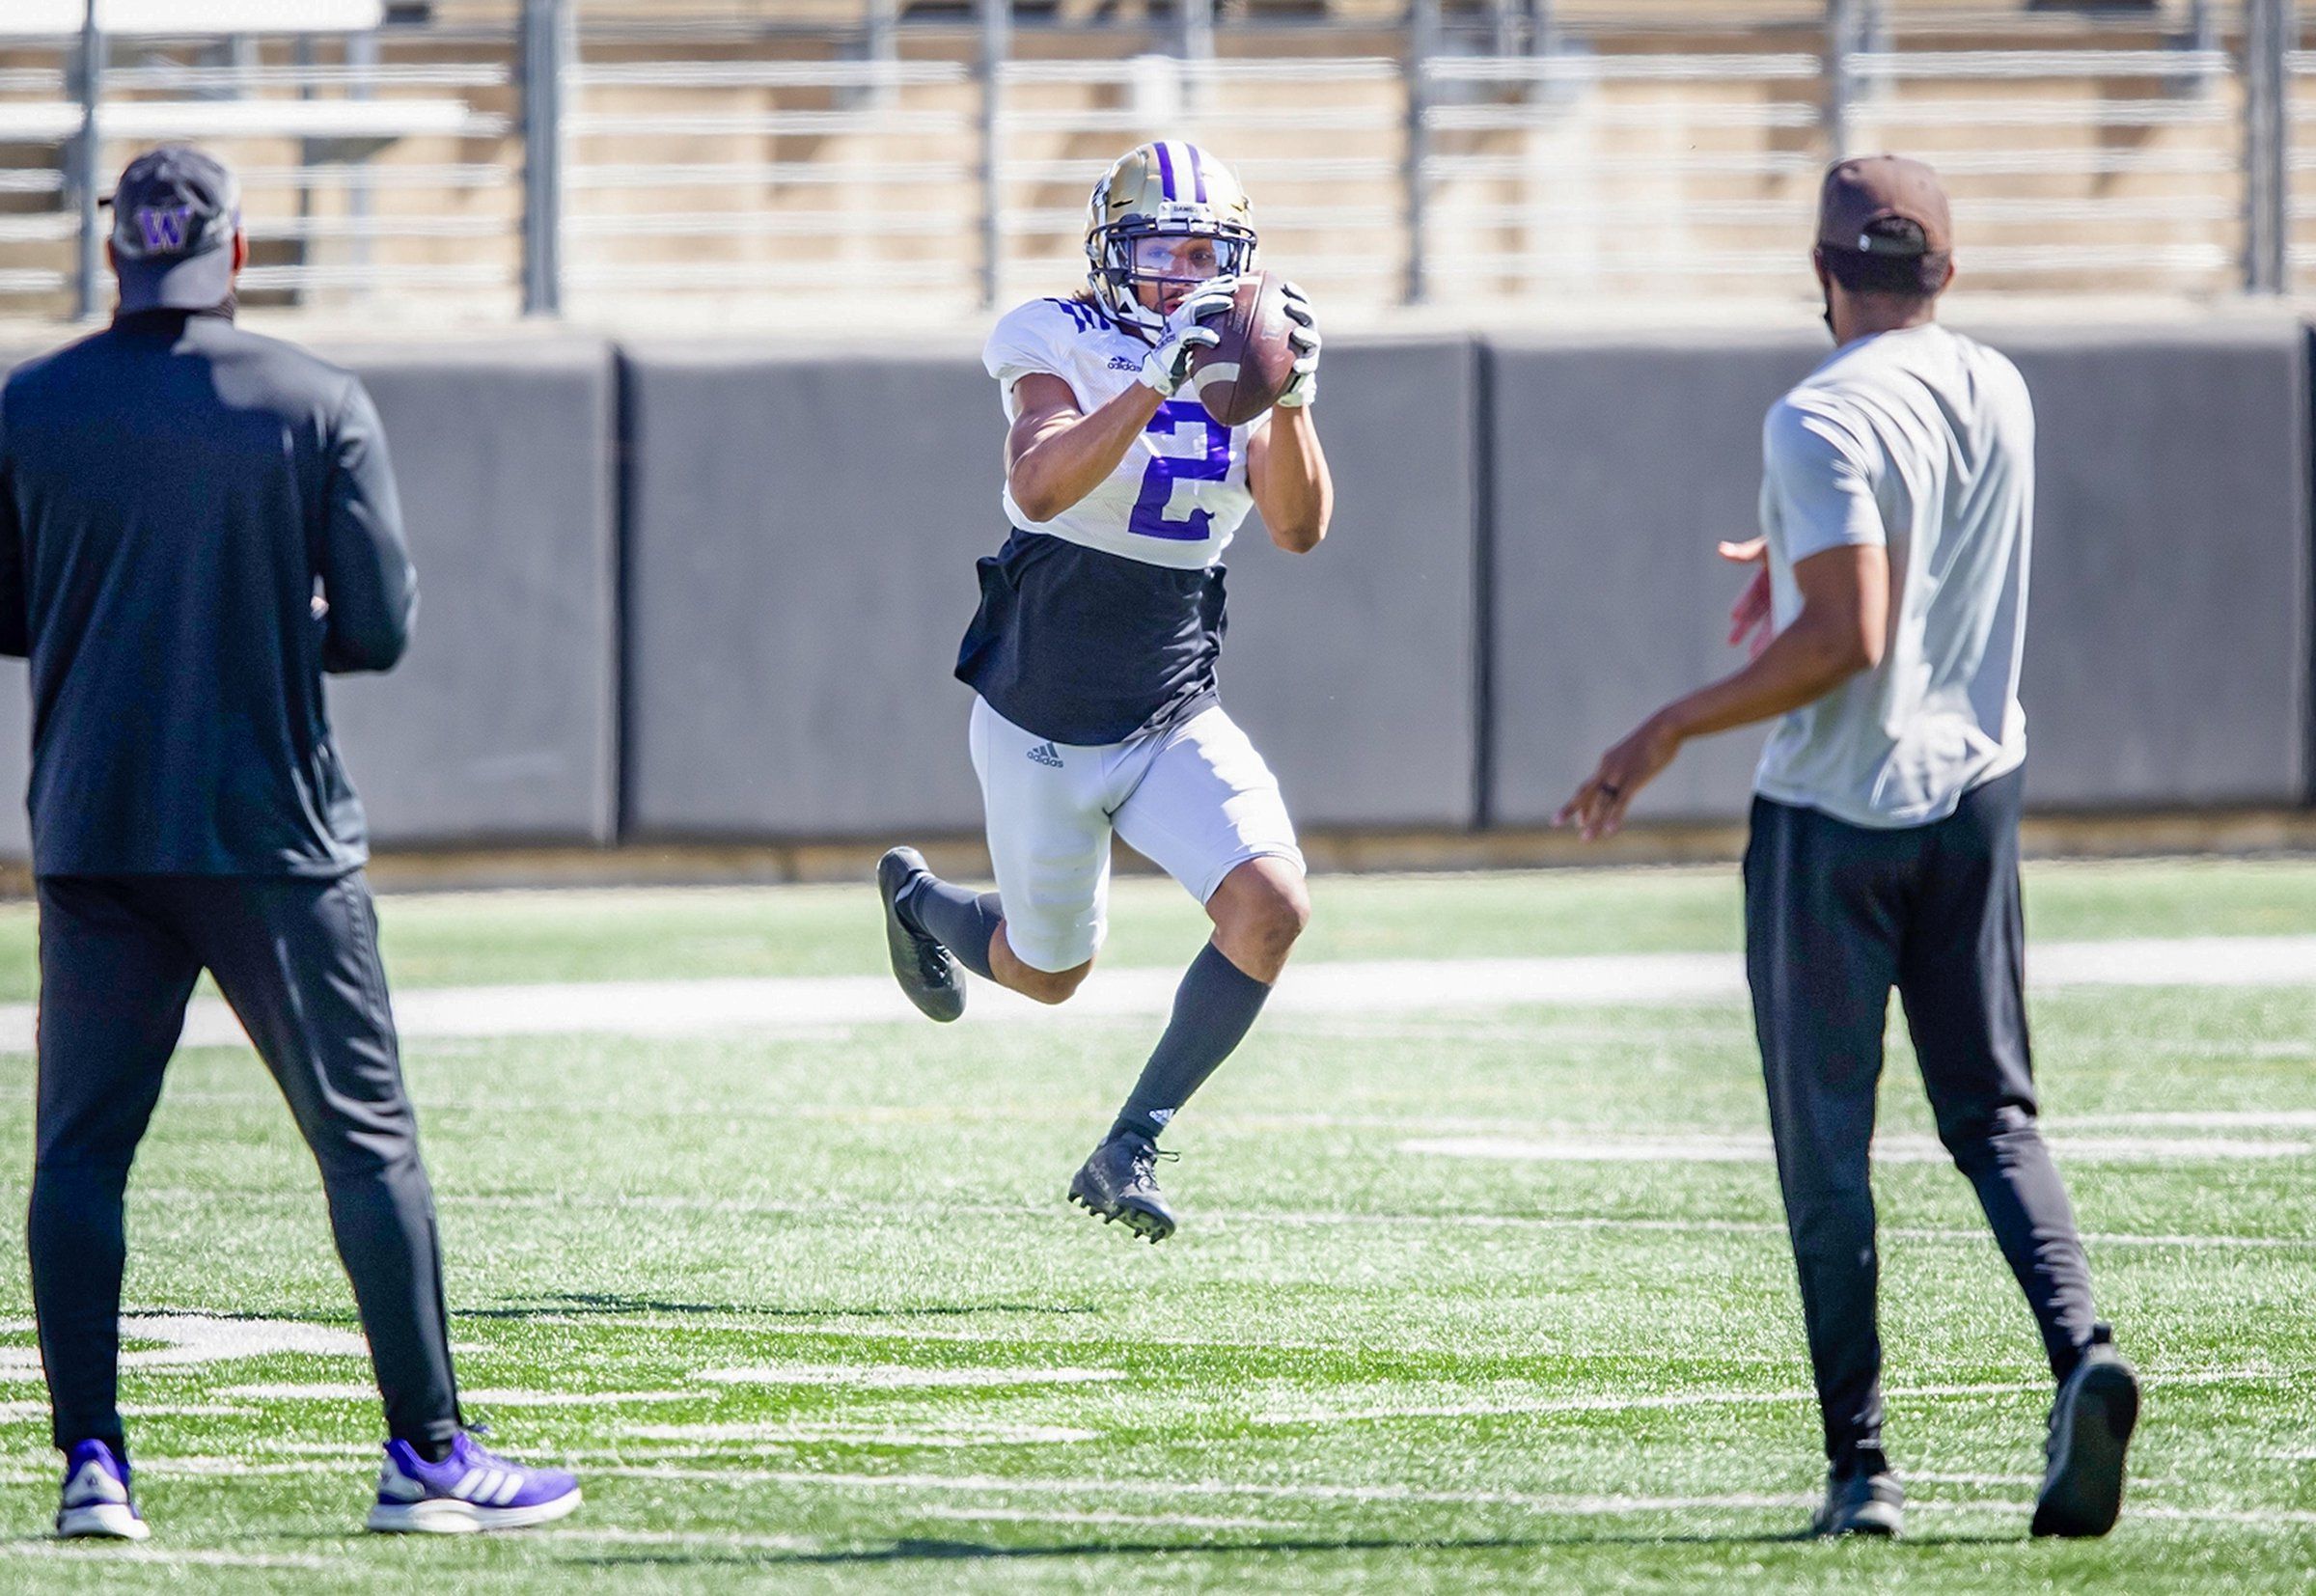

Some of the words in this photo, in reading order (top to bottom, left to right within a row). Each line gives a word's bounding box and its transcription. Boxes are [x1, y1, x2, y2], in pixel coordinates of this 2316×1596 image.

[136, 206, 193, 252] W
[1128, 400, 1232, 540] 2
[1028, 752, 1064, 768] adidas
